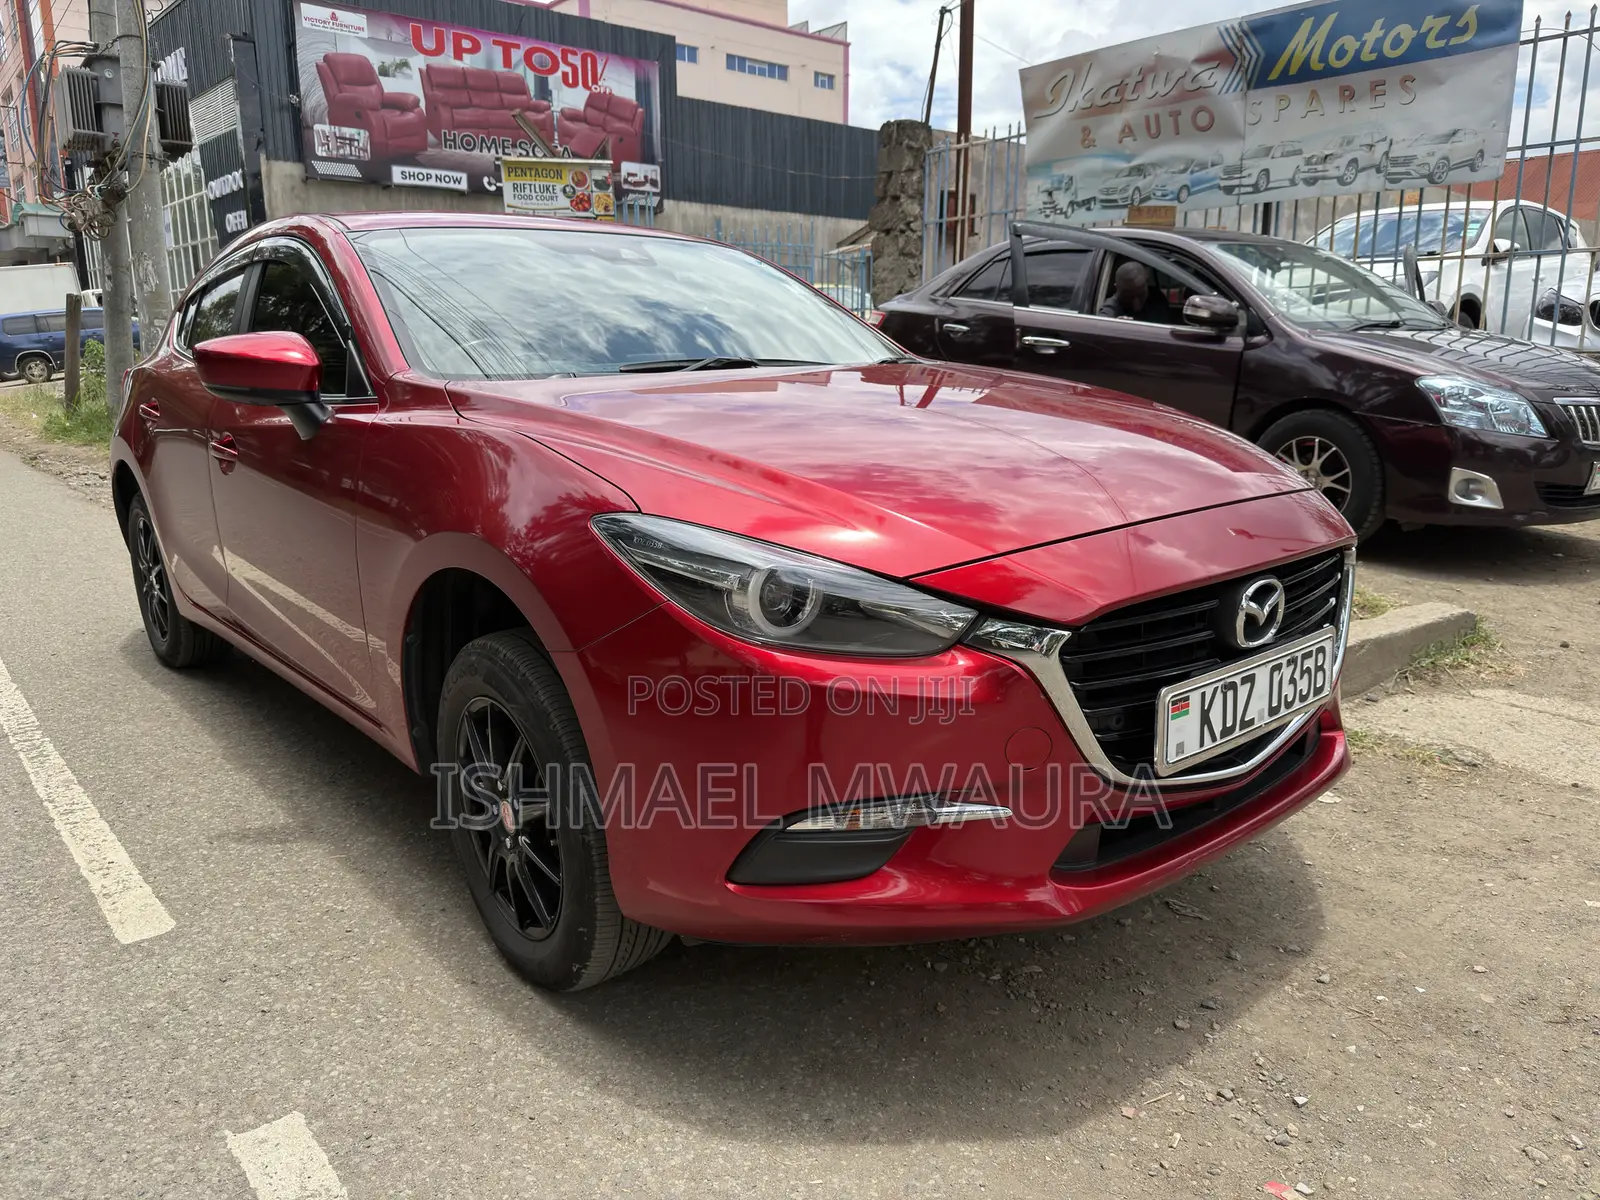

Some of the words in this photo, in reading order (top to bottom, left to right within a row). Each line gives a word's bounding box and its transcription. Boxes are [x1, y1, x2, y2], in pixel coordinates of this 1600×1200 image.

[303, 16, 331, 26] VICTORY
[332, 22, 365, 32] FURNITURE
[410, 23, 483, 61] UP
[492, 38, 560, 77] TO
[1267, 4, 1481, 81] Motors
[1080, 125, 1097, 149] &
[1118, 105, 1215, 144] AUTO
[1245, 74, 1417, 126] SPARES
[442, 130, 512, 157] HOME
[516, 139, 573, 159] SOA
[400, 170, 433, 182] SHOP
[435, 174, 463, 185] NOW
[507, 166, 563, 180] PENTAGON
[512, 183, 557, 194] RIFTLUKE
[1200, 673, 1256, 748] KDZ
[1268, 645, 1326, 718] 035B
